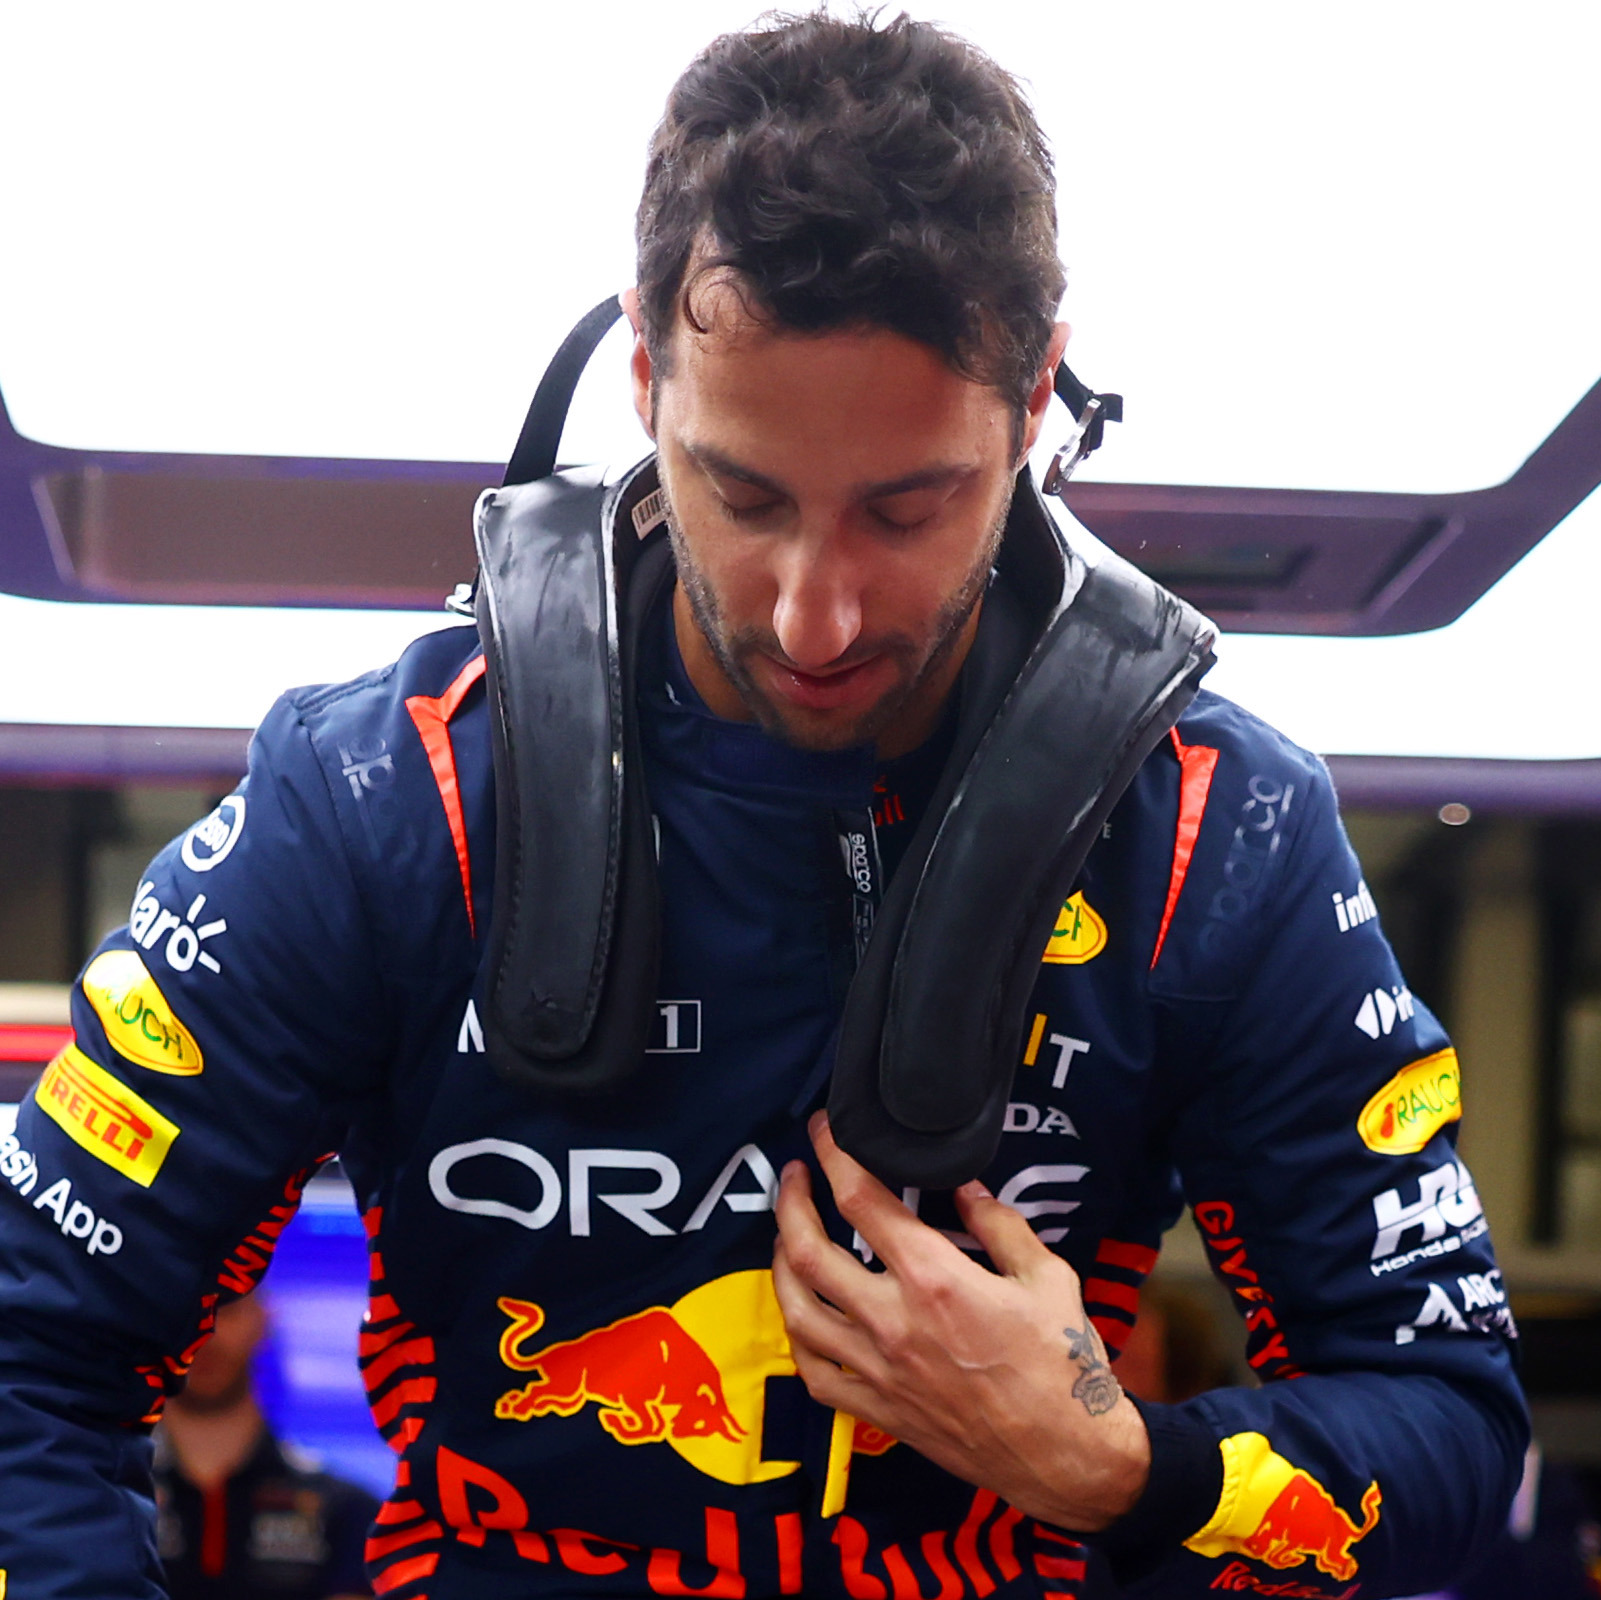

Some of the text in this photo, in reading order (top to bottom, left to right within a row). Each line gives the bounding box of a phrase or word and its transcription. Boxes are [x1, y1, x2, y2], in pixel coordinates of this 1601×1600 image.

[130, 878, 199, 972] laro
[33, 1177, 123, 1255] App
[1370, 1236, 1461, 1277] Honda
